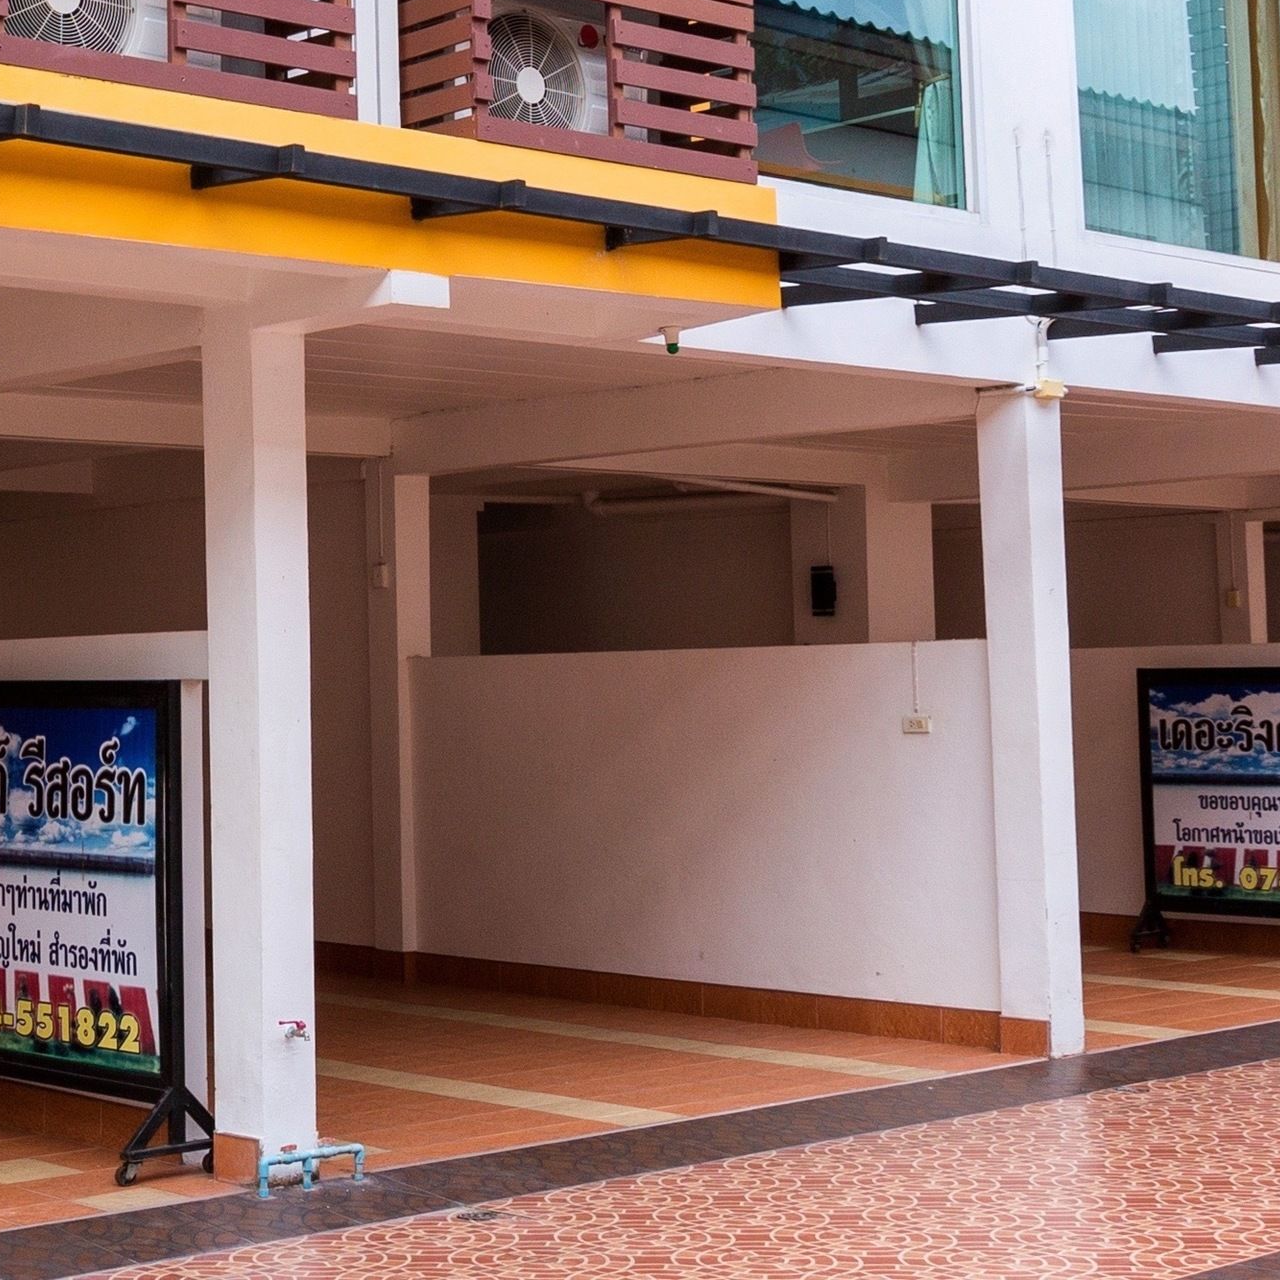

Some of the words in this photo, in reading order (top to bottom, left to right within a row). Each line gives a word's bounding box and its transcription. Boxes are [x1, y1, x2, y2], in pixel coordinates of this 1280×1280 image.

[20, 736, 147, 826] รีสอร์ท
[1172, 856, 1224, 890] โทร.
[49, 928, 138, 976] สำรองที่พัก
